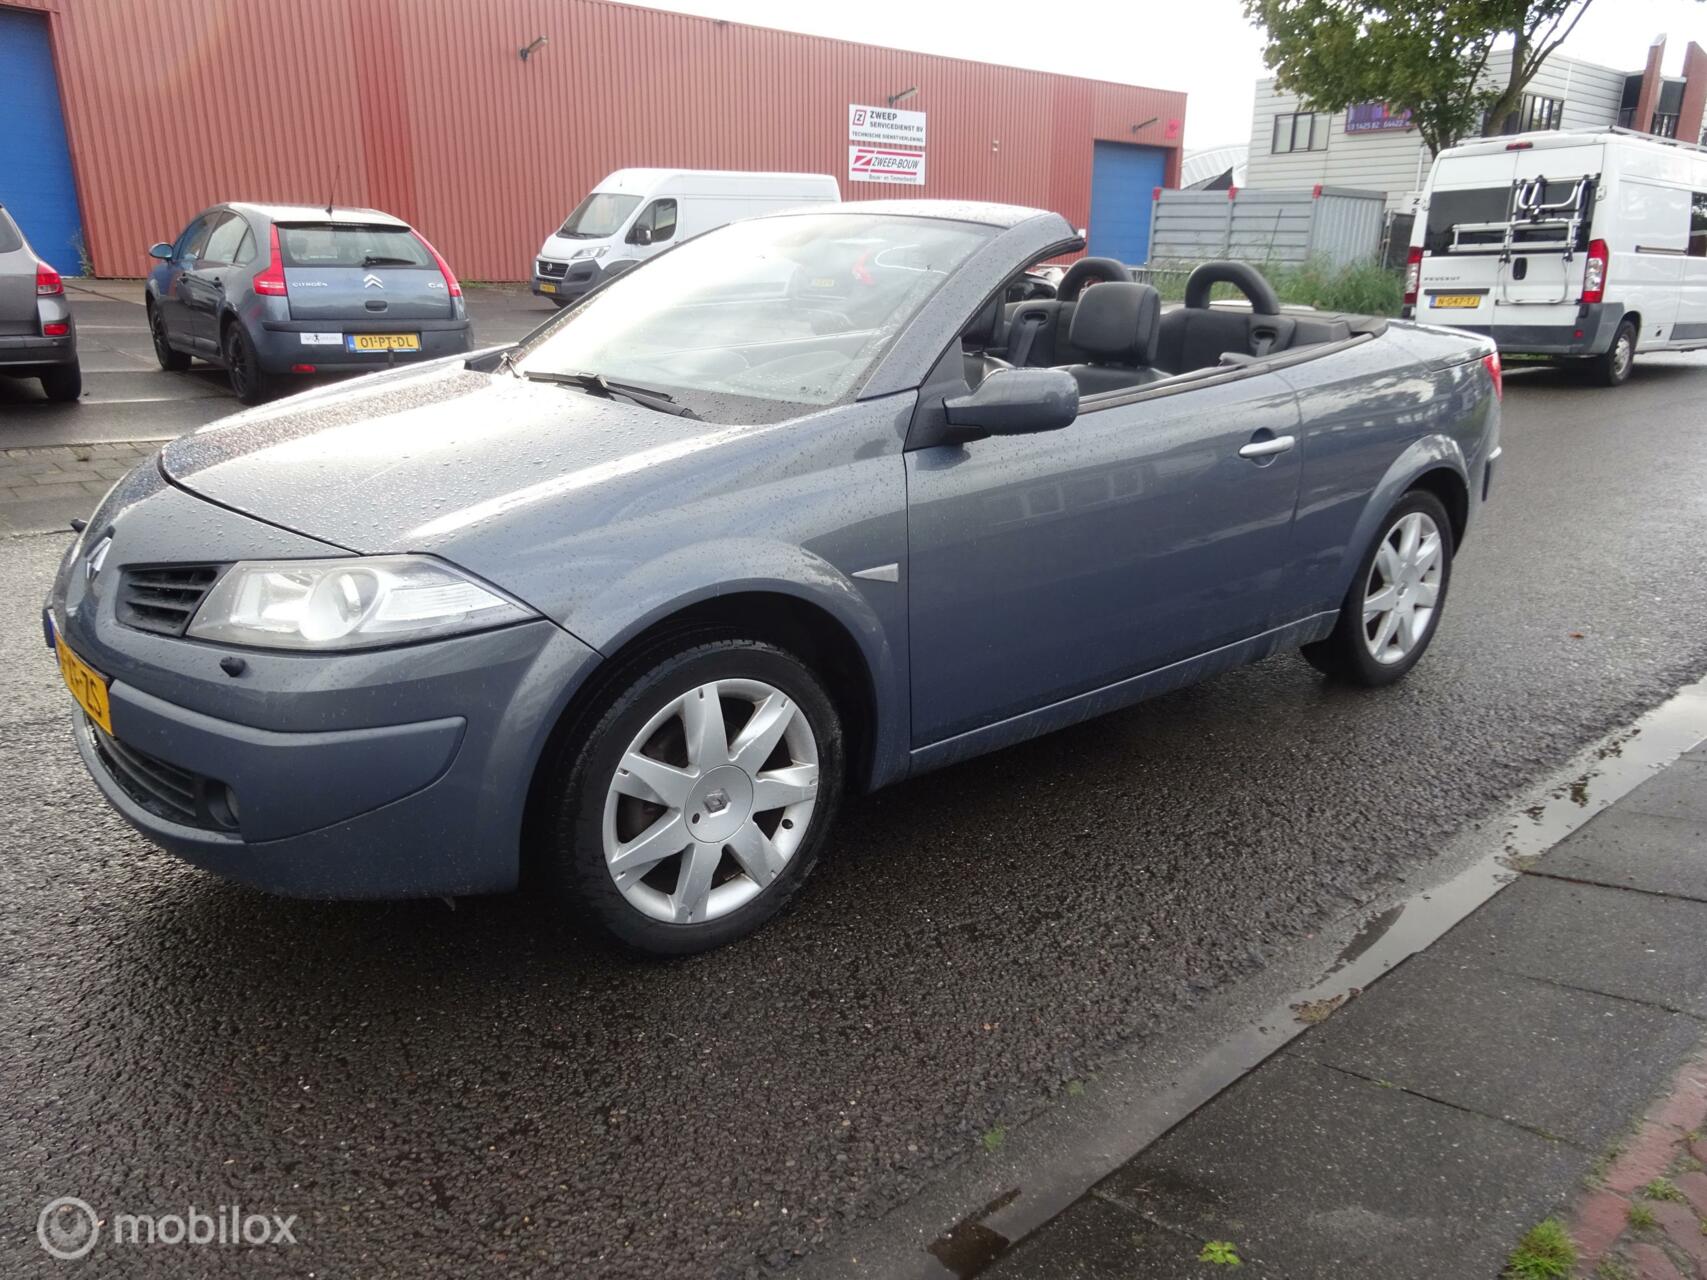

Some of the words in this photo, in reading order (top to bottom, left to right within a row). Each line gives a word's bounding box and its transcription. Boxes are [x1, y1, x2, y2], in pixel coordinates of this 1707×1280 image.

[870, 111, 897, 121] ZWEEP
[870, 121, 914, 132] SERVICEDIENST
[852, 130, 881, 139] TECHNISCHE
[872, 156, 920, 169] ZWEEP-BOUW
[427, 281, 445, 289] C4
[360, 336, 414, 348] 01-PT-DL
